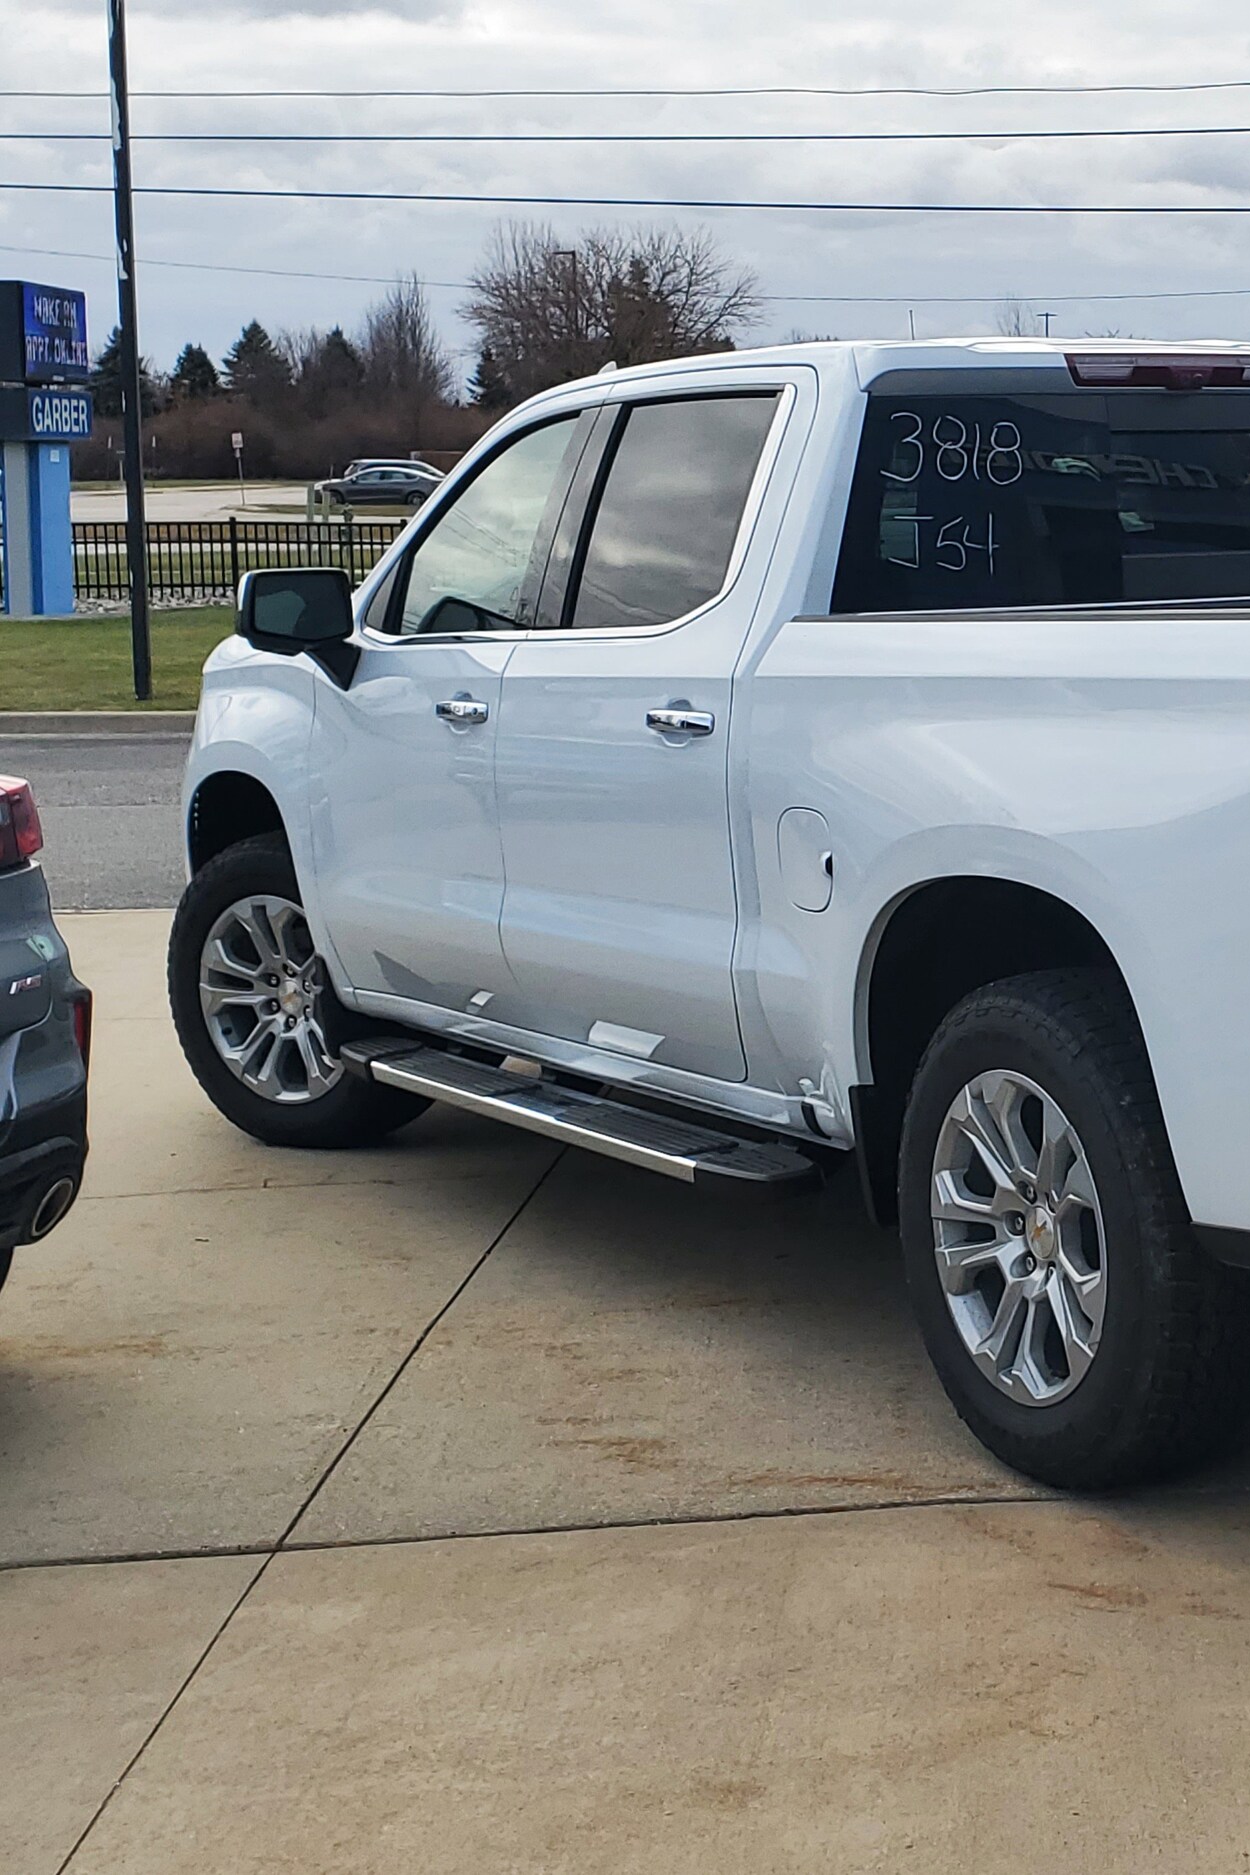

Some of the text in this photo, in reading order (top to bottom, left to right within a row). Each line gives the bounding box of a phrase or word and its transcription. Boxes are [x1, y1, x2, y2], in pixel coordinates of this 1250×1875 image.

[34, 295, 61, 326] MAKE
[32, 395, 89, 433] GARBER
[880, 412, 1023, 485] 3818
